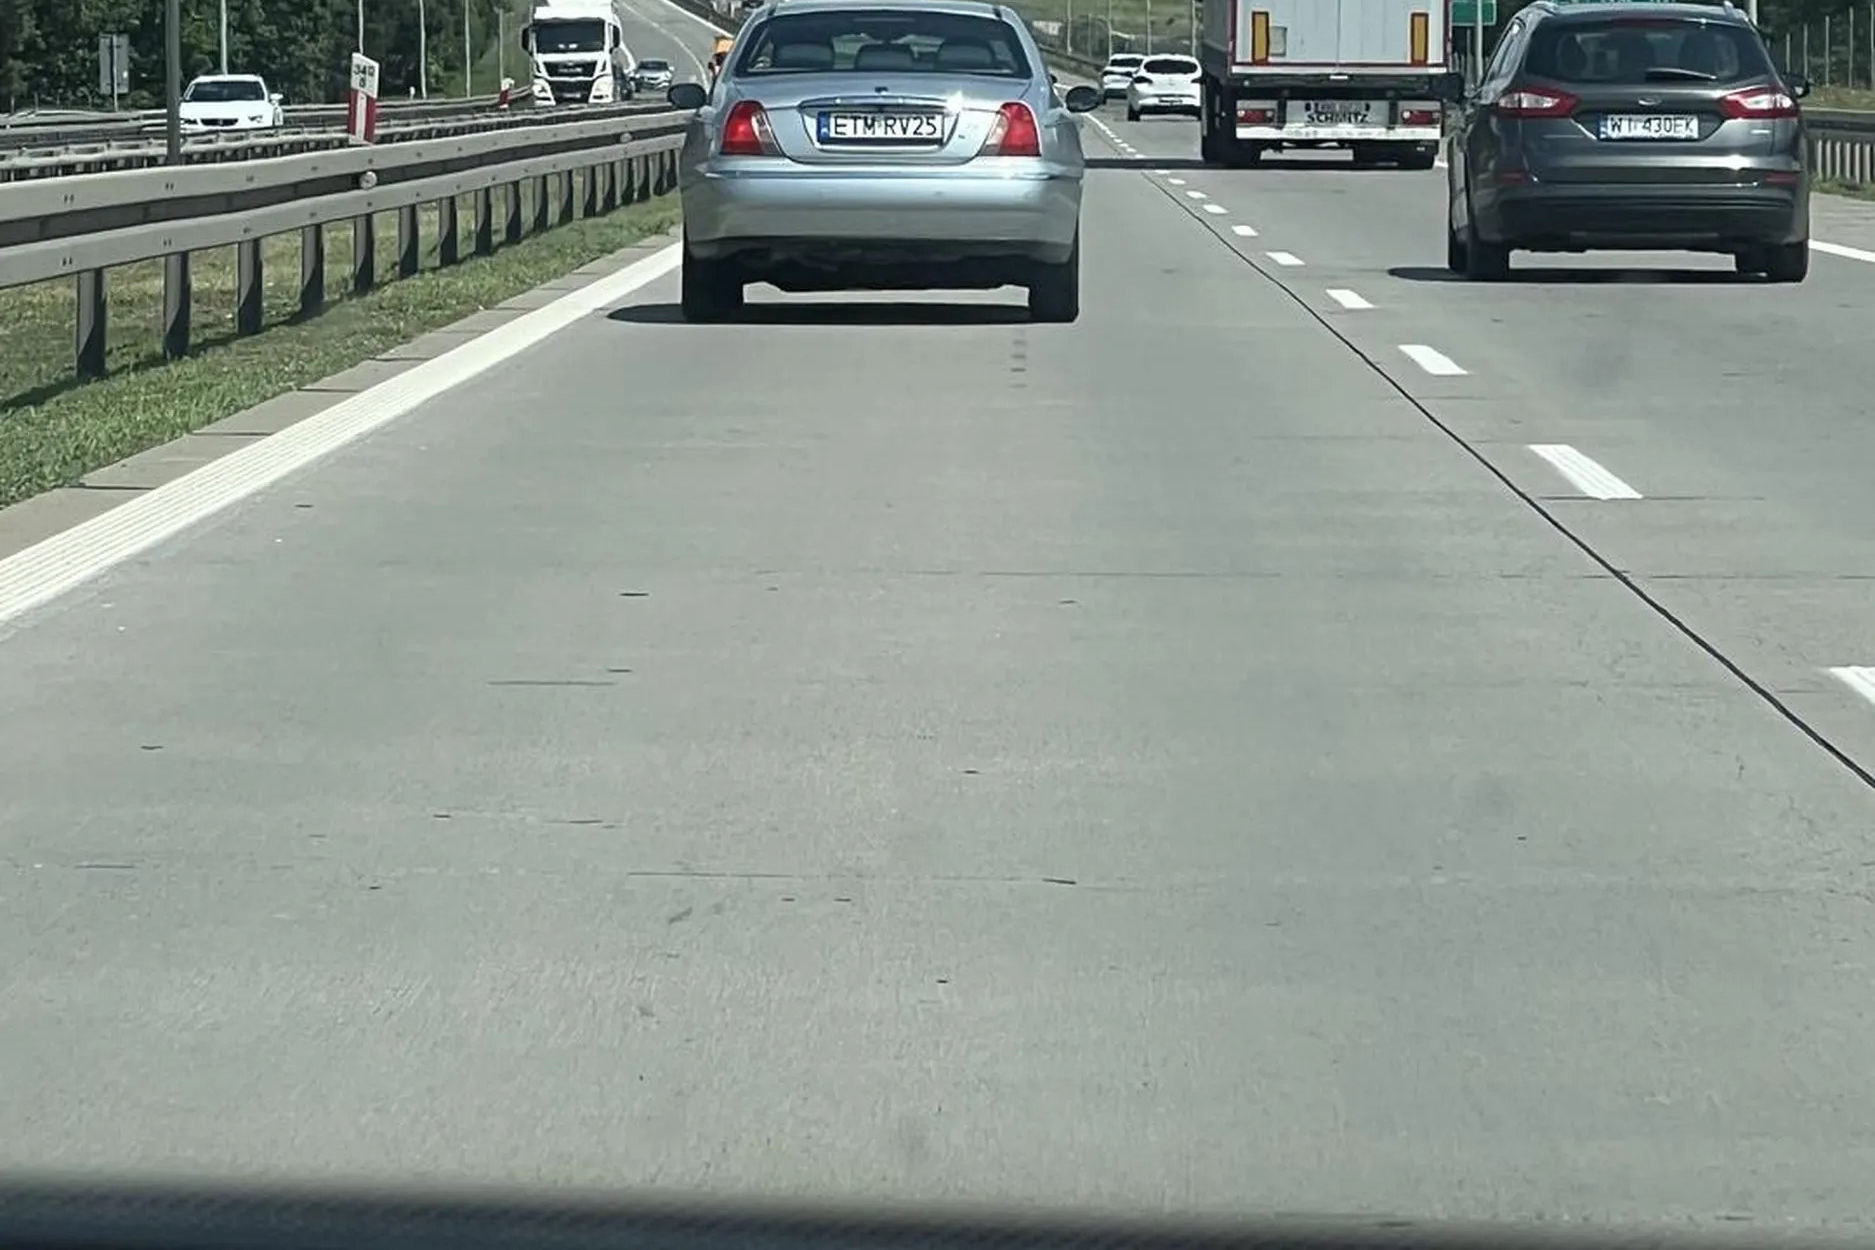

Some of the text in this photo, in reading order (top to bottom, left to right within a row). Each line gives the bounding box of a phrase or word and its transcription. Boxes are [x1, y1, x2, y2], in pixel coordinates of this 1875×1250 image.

[834, 115, 937, 136] ETM RV25
[1641, 116, 1694, 134] 430EK
